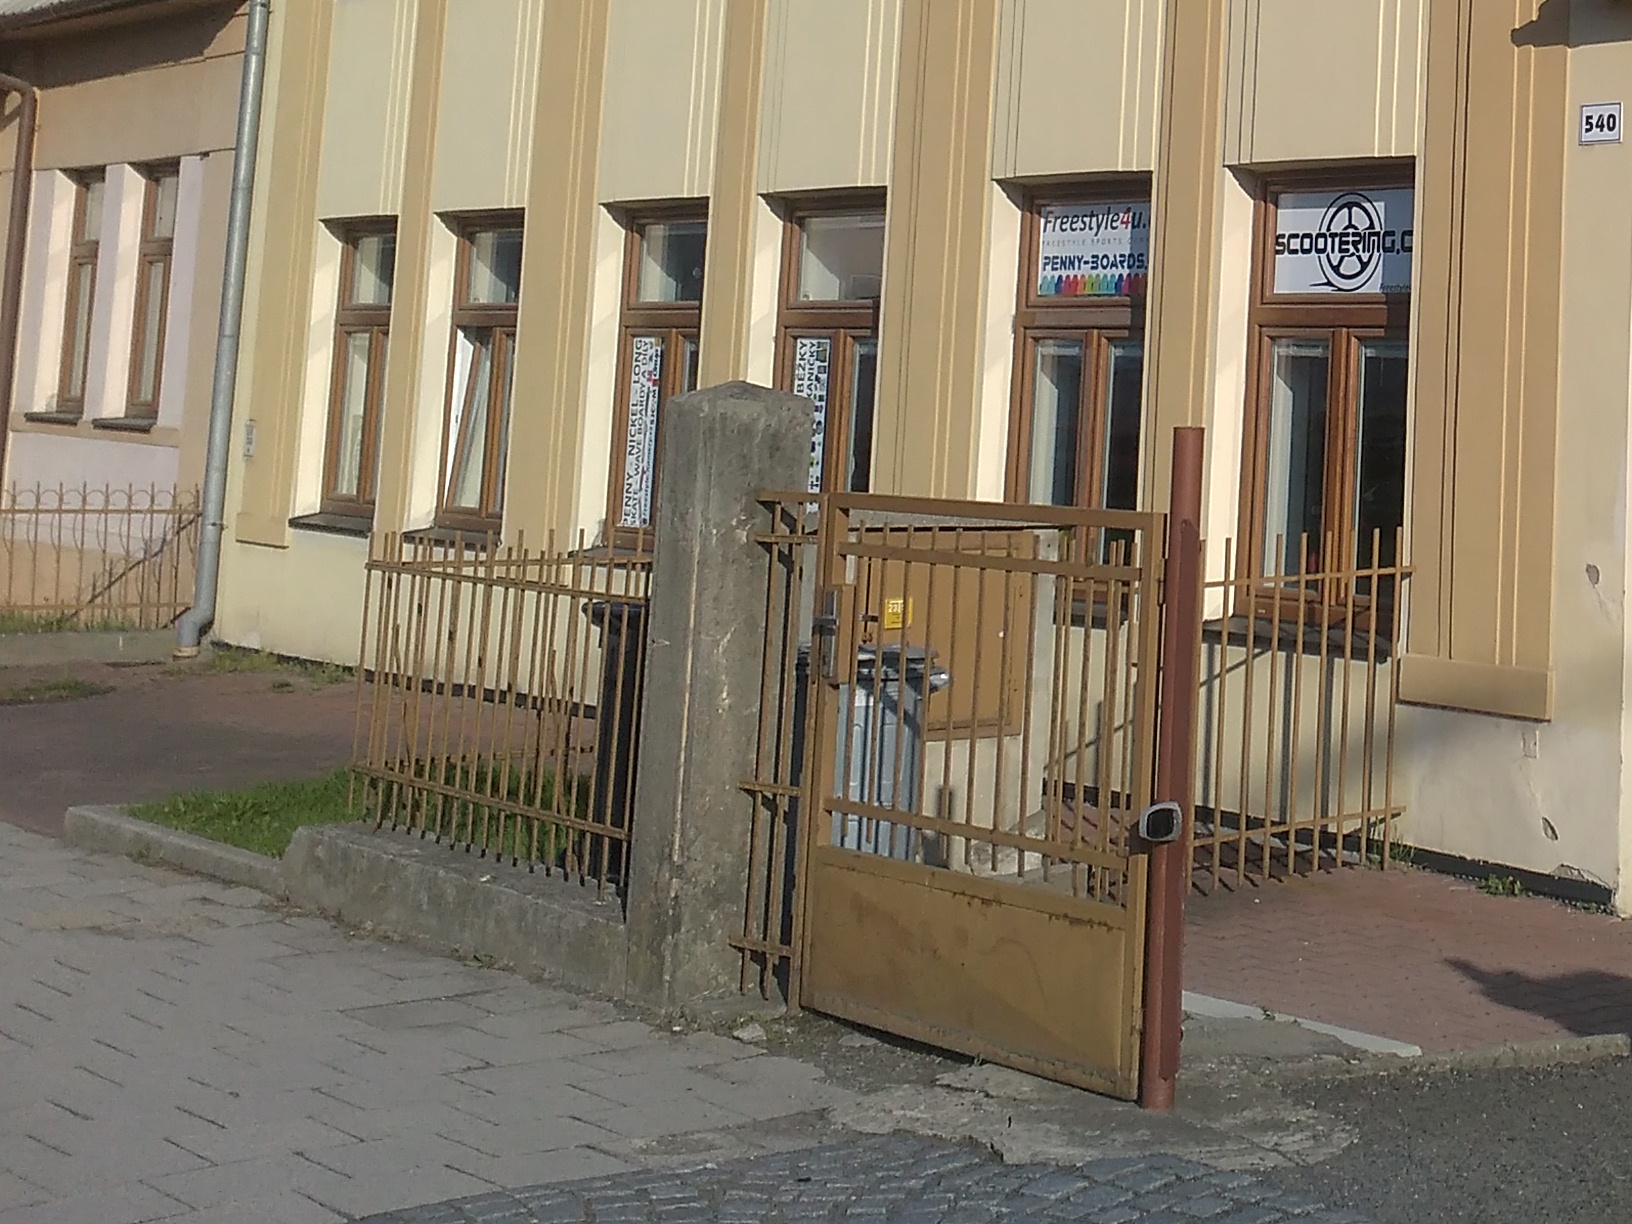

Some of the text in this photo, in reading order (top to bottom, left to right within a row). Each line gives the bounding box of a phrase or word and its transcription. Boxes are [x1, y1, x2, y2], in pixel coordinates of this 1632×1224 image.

[1585, 113, 1617, 133] 540
[1043, 206, 1151, 237] Freestyle4u.
[628, 399, 638, 456] NICKEL
[633, 339, 642, 384] LONG
[634, 437, 642, 476] WAVE
